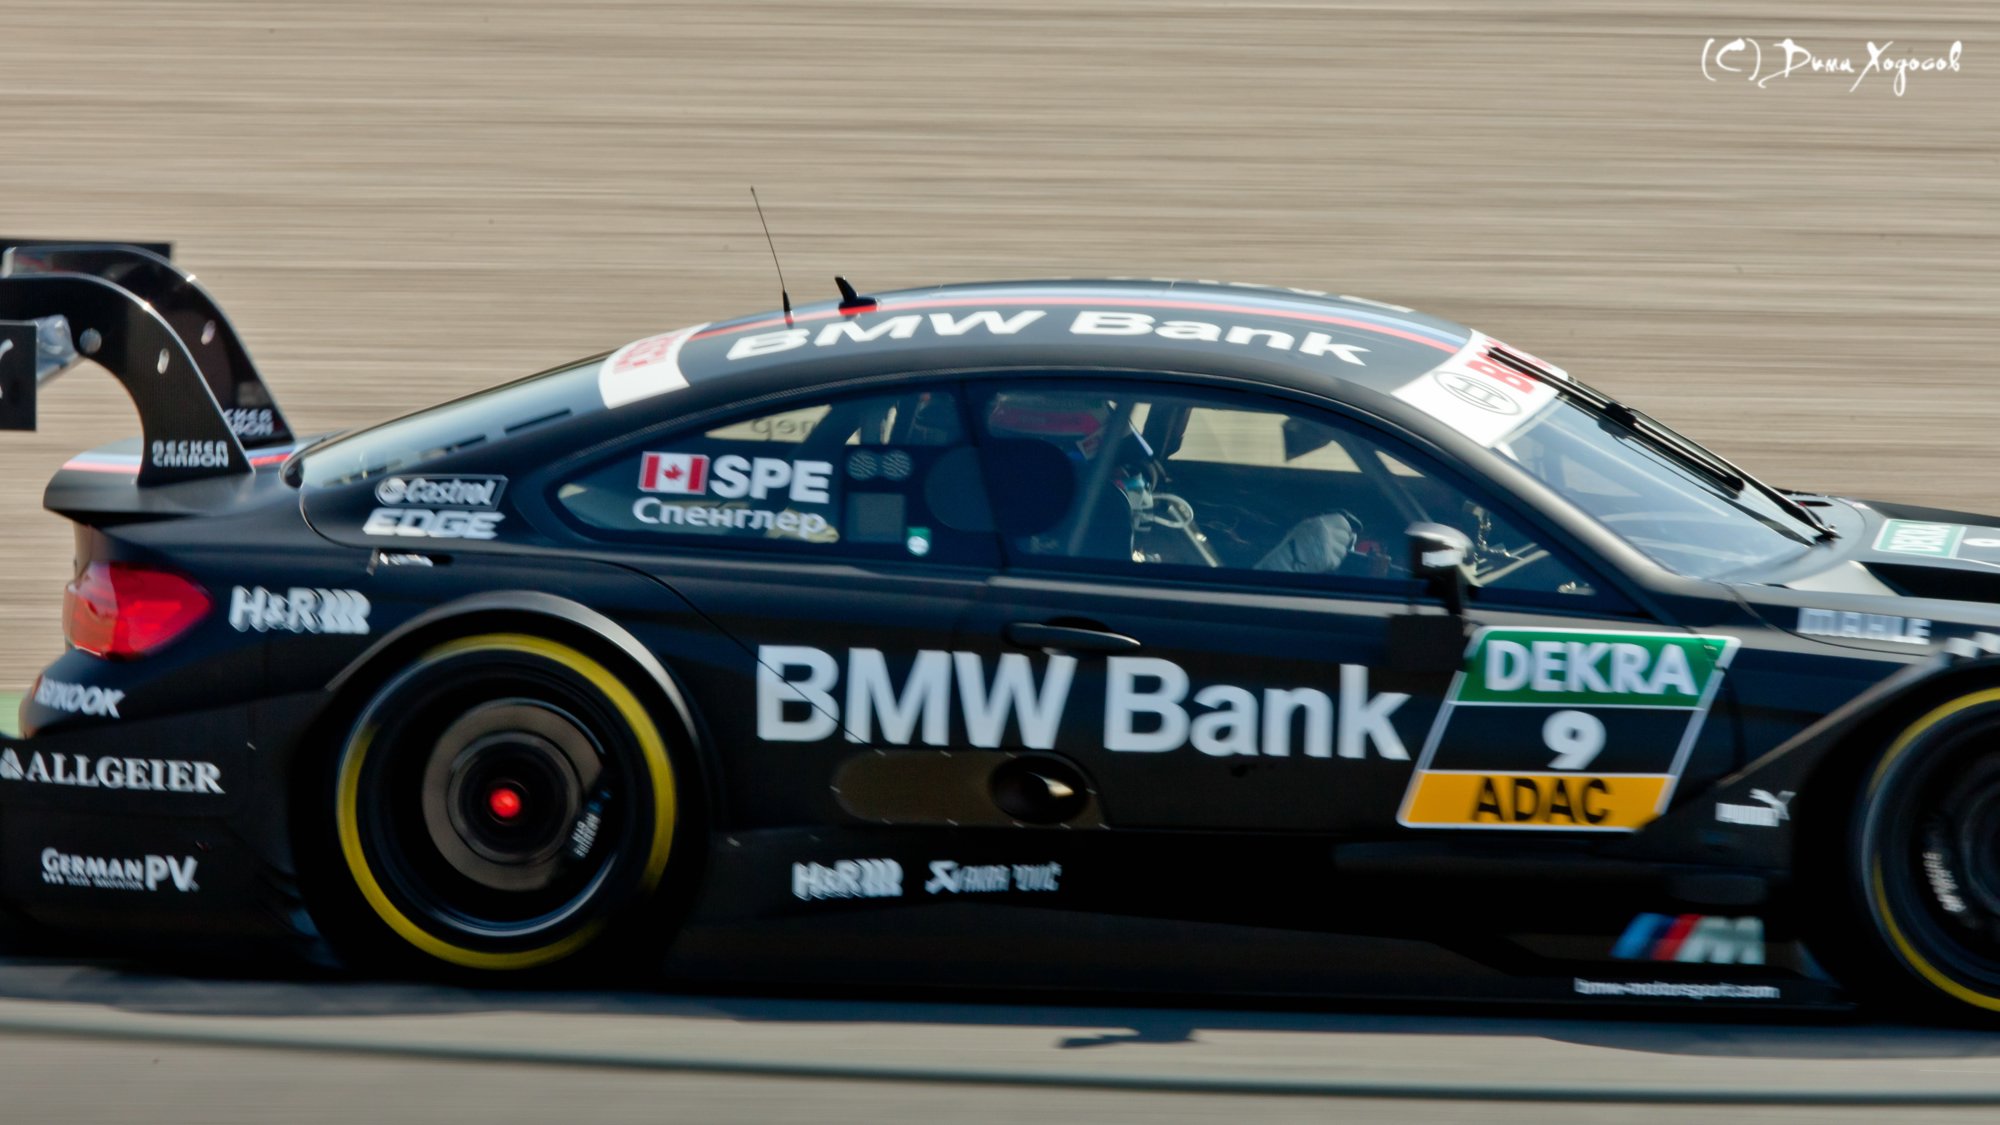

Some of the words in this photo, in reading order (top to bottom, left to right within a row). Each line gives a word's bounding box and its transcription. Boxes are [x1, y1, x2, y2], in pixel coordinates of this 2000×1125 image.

[726, 309, 1048, 360] BMW
[1069, 310, 1372, 366] Bank
[406, 477, 496, 506] Castrol
[709, 454, 834, 504] SPE
[362, 508, 506, 540] EDGE
[632, 496, 828, 541] Спенглер
[1484, 639, 1700, 696] DEKRA
[756, 645, 1077, 750] BMW
[1103, 655, 1411, 760] Bank
[1541, 709, 1608, 771] 9
[25, 750, 226, 795] ALLGEIER
[1471, 777, 1612, 824] ADAC
